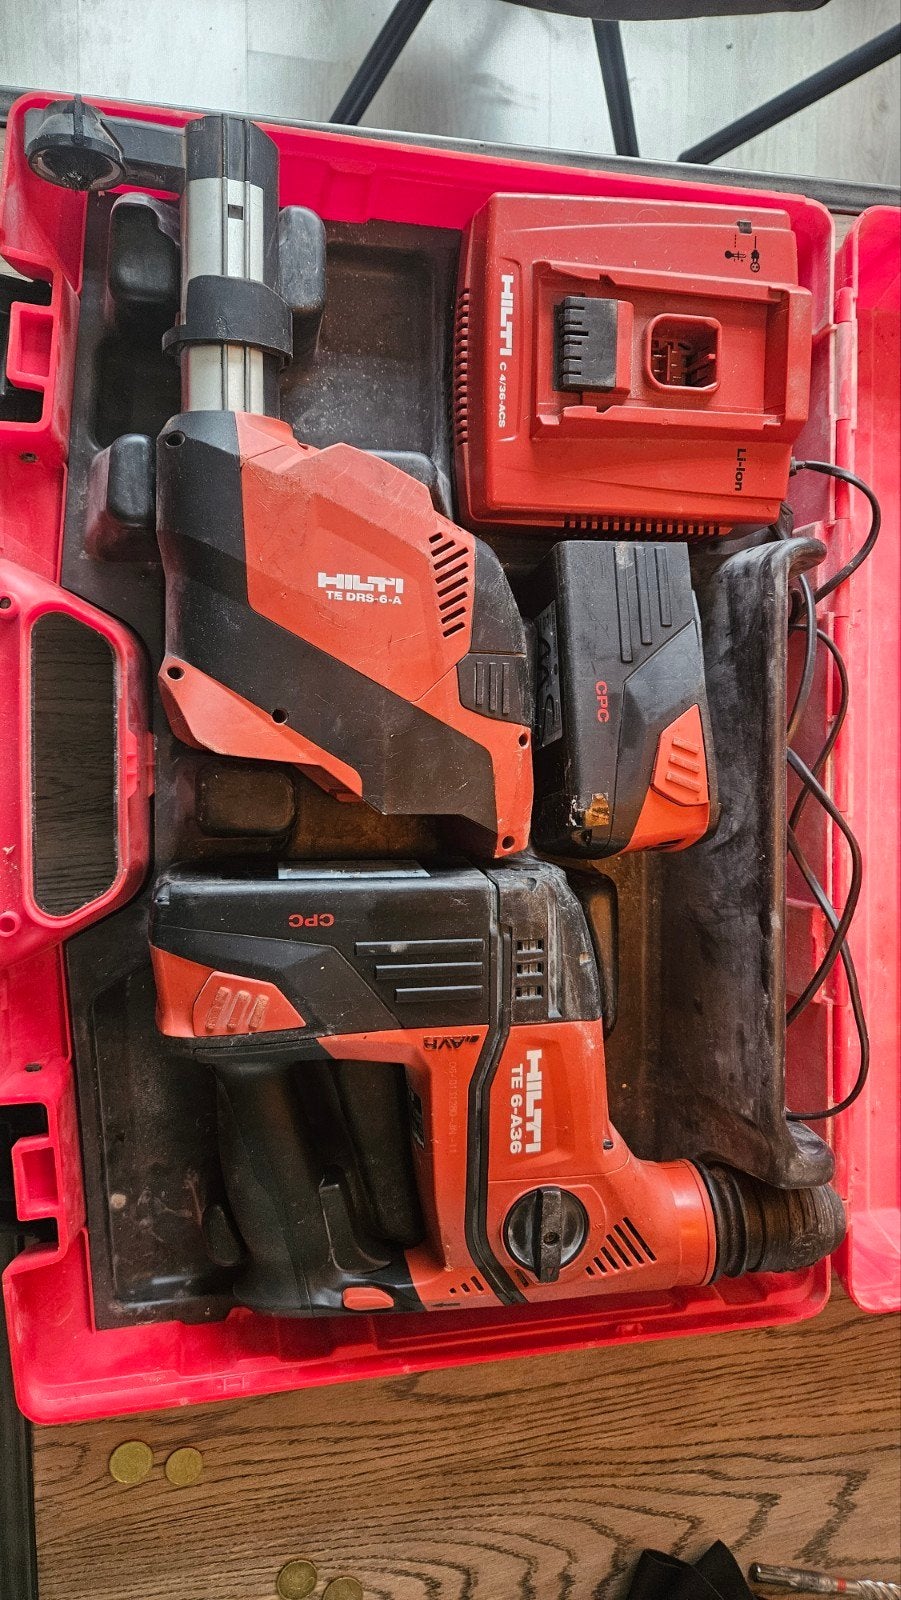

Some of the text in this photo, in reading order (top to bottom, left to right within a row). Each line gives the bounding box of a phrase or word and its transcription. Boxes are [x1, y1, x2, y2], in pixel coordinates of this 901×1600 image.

[498, 274, 514, 428] HILTI C 4/36-ACS
[734, 448, 747, 491] Li-Ion
[317, 572, 404, 594] HILTI
[325, 590, 402, 605] TE DRS-6-A
[595, 680, 610, 723] CPC
[288, 913, 335, 928] CPC
[509, 1063, 523, 1154] TE 6-A36
[525, 1049, 543, 1153] HILTI
